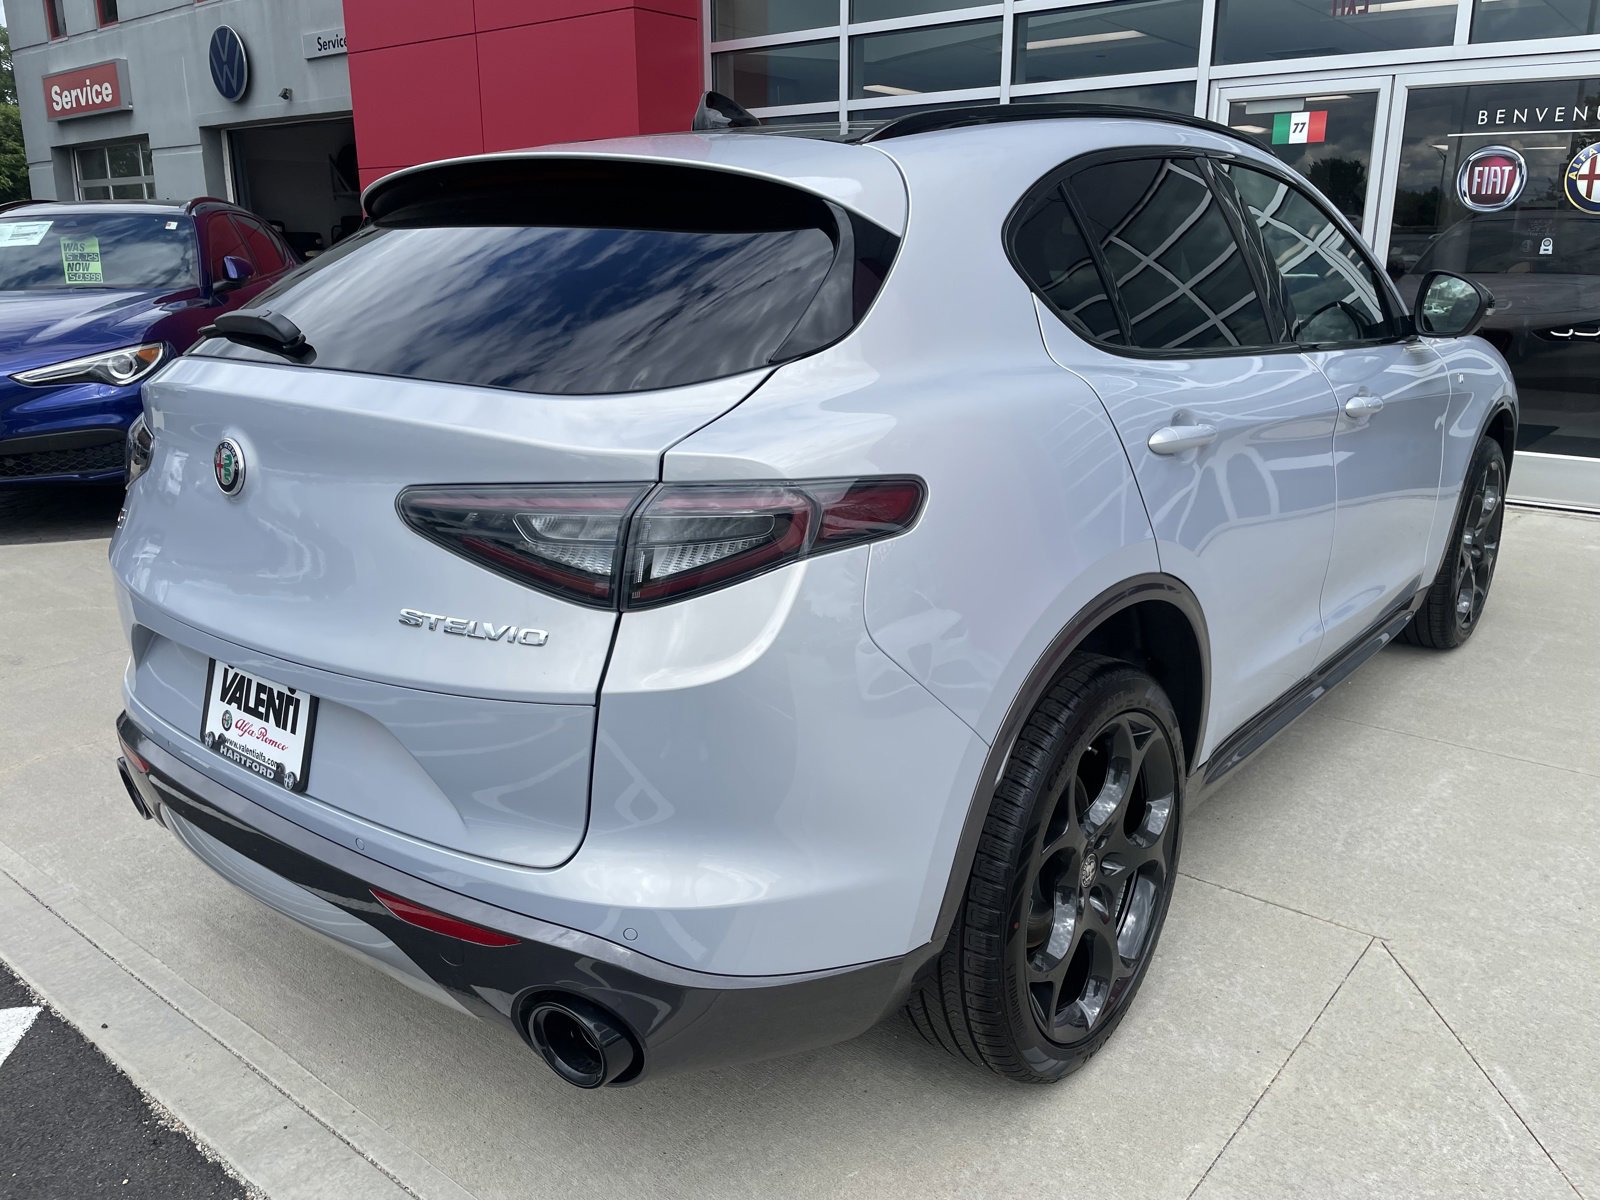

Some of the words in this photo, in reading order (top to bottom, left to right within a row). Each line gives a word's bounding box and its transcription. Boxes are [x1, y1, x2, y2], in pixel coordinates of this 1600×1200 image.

[51, 79, 112, 111] Service
[1292, 122, 1307, 133] 77
[1477, 105, 1600, 125] BENVEN
[1568, 147, 1598, 180] ALFA
[1471, 166, 1513, 195] FIAT
[63, 242, 86, 252] WAS
[67, 262, 90, 272] NOW
[399, 608, 550, 647] STELVIO
[220, 667, 301, 735] VALENTI
[235, 718, 256, 737] Alfa
[256, 726, 288, 751] Romeo
[220, 745, 275, 779] HARTFORD
